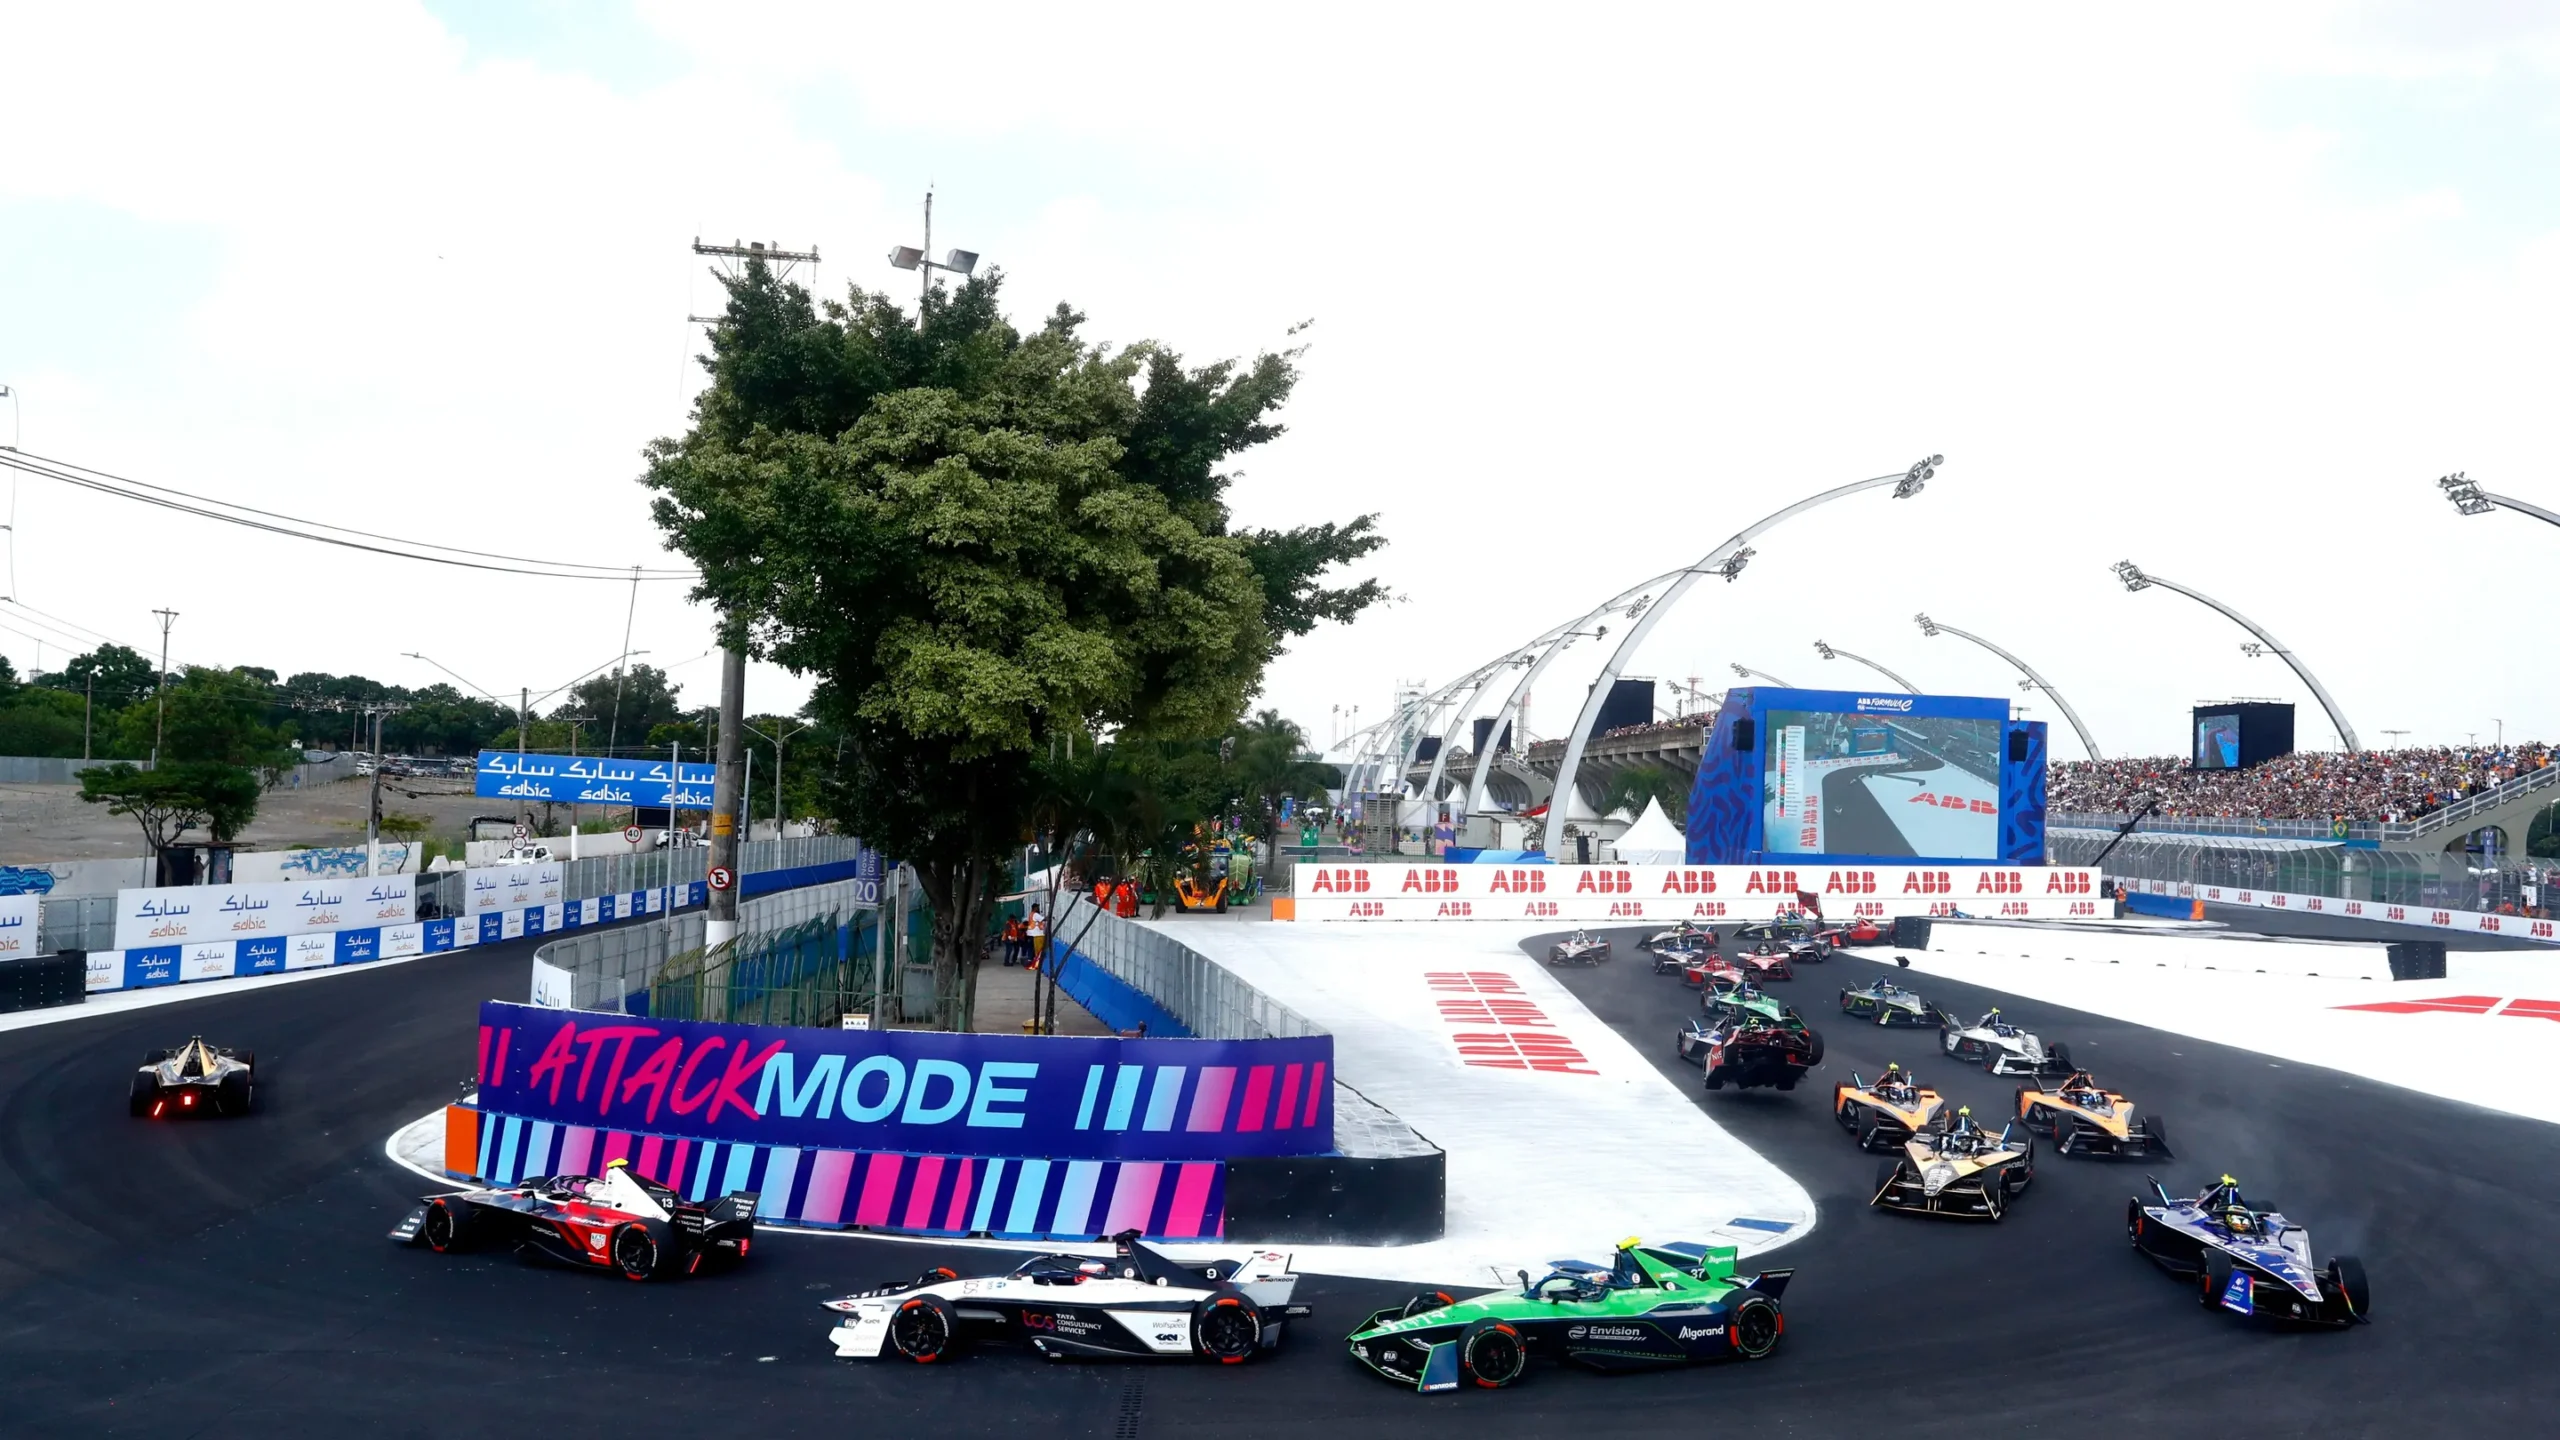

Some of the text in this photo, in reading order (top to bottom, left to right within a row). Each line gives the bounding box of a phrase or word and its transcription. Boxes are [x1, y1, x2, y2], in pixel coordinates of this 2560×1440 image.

[479, 756, 554, 780] سابك
[559, 761, 635, 784] سابك
[498, 780, 552, 798] sabic
[578, 784, 632, 802] sabic
[1908, 792, 1997, 814] ABB
[628, 830, 640, 838] 40
[868, 846, 876, 876] (Dispe
[716, 872, 724, 884] E
[1312, 870, 2090, 894] ABB ABB ABB ABB ABB ABB ABB ABB ABB ABB
[856, 881, 877, 902] 20
[135, 886, 406, 922] سابك سابك سابك سابك
[1349, 902, 1384, 916] ABB
[1438, 902, 1472, 916] ABB
[1525, 902, 1558, 916] ABB
[1610, 902, 1642, 916] ABB
[1694, 902, 1726, 916] ABB
[1854, 902, 1884, 916] ABB
[1930, 902, 1956, 916] ABB
[2001, 902, 2028, 915] ABB
[2069, 902, 2094, 914] ABB
[149, 904, 405, 938] sabic sabic sabic sabic
[2271, 894, 2286, 906] ABB
[2307, 898, 2322, 910] ABB
[2345, 902, 2362, 914] ABB
[2387, 907, 2404, 920] ABB
[2431, 912, 2450, 925] ABB
[2480, 916, 2500, 931] ABB
[2530, 922, 2552, 937] ABB
[86, 960, 112, 974] ساب
[137, 954, 171, 969] سابك
[530, 1021, 1039, 1128] ATTACK MODE
[662, 1198, 674, 1208] 13
[1206, 1268, 1217, 1280] 9
[1690, 1268, 1705, 1279] 37
[1022, 1310, 1055, 1330] tcs
[1057, 1320, 1102, 1330] CONSULTANCY
[1152, 1321, 1186, 1330] Wolfspeed
[1058, 1326, 1086, 1335] SERVICES
[1590, 1326, 1640, 1336] Envision
[1678, 1324, 1724, 1340] Algorand
[1384, 1352, 1397, 1360] FIA
